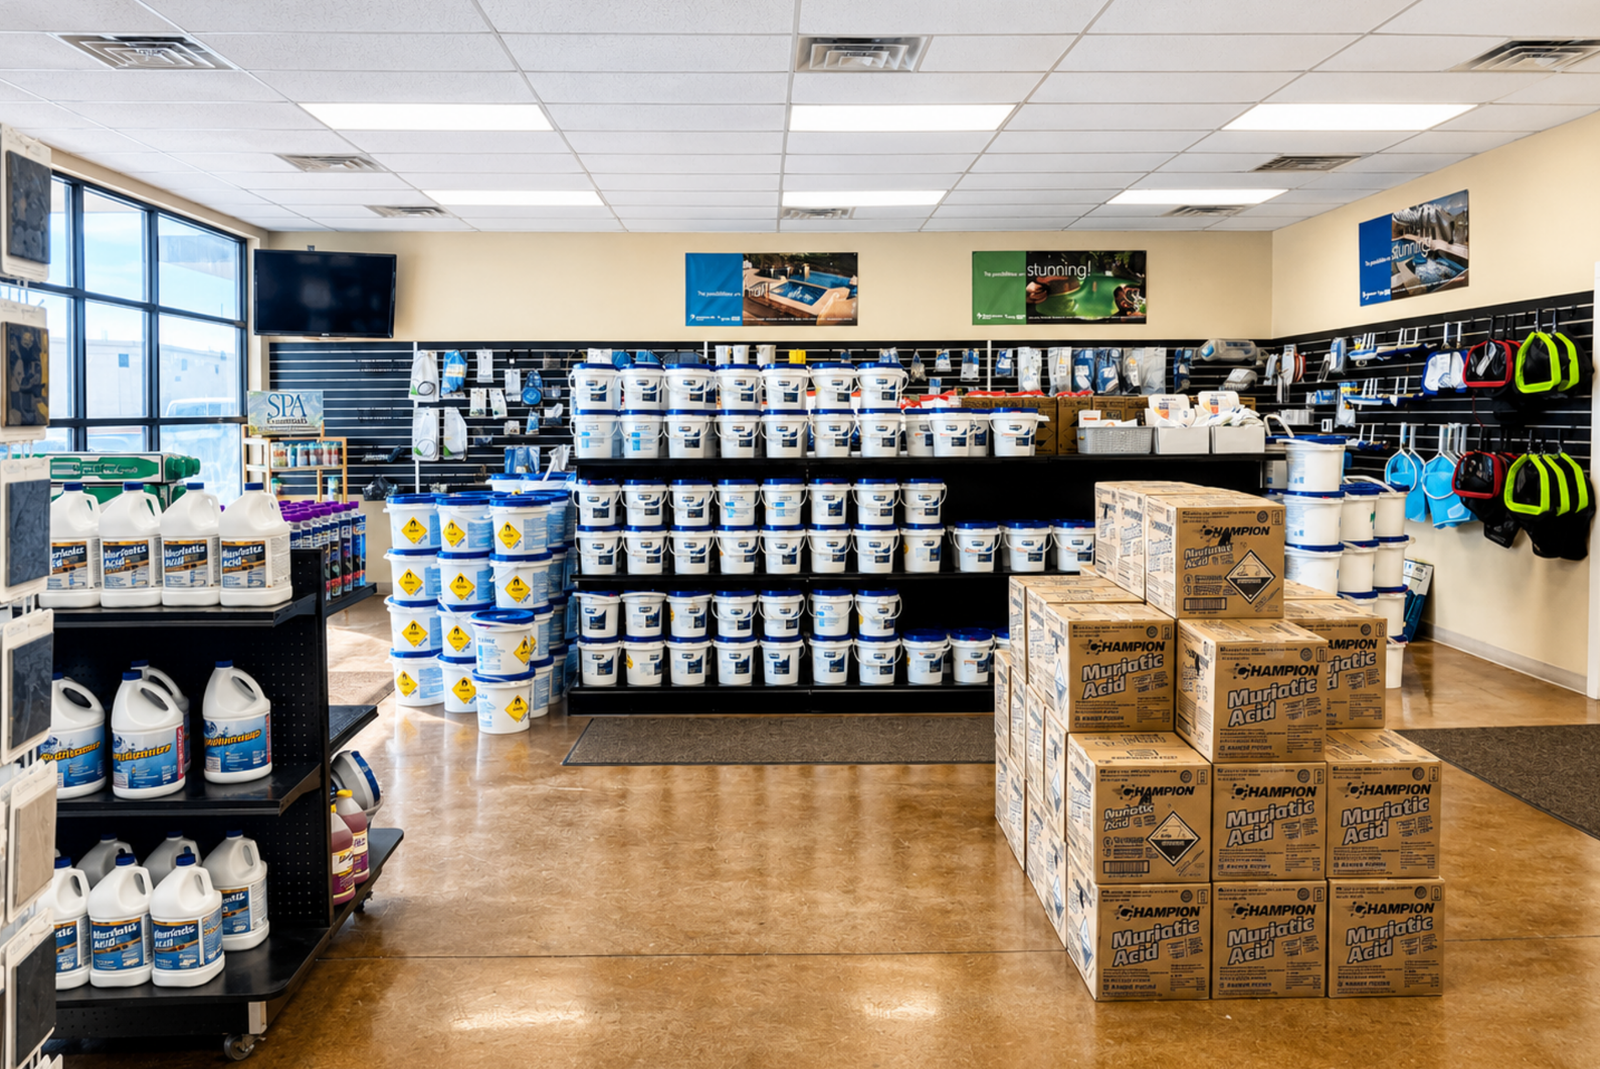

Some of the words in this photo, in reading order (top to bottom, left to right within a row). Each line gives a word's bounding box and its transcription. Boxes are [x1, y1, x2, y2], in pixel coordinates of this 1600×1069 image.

[267, 393, 307, 418] SPA
[1086, 639, 1166, 655] CHAMPION
[1328, 639, 1378, 650] AMPION
[1082, 652, 1164, 682] Muriatic
[1233, 663, 1320, 680] CHAMPION
[1327, 650, 1377, 675] riatic
[1082, 675, 1126, 700] Acid
[1228, 677, 1317, 709] Muriatic
[1228, 699, 1276, 728] Acid
[1120, 784, 1195, 800] CHAMPION
[1231, 783, 1317, 800] CHAMPION
[1345, 781, 1432, 799] CHAMPION
[1226, 798, 1315, 829] Muriatic
[1341, 796, 1430, 827] Muriatic
[1226, 820, 1275, 848] Acid
[1341, 819, 1389, 846] Acid
[1116, 904, 1200, 922] CHAMPION
[1231, 902, 1316, 919] CHAMPION
[1351, 901, 1435, 919] CHAMPION
[1112, 918, 1200, 949] Muriatic
[1227, 916, 1315, 948] Muriatic
[1346, 915, 1433, 946] Muriatic
[1112, 941, 1159, 968] Acid
[1227, 938, 1275, 966] Acid
[1346, 938, 1393, 965] Acid
